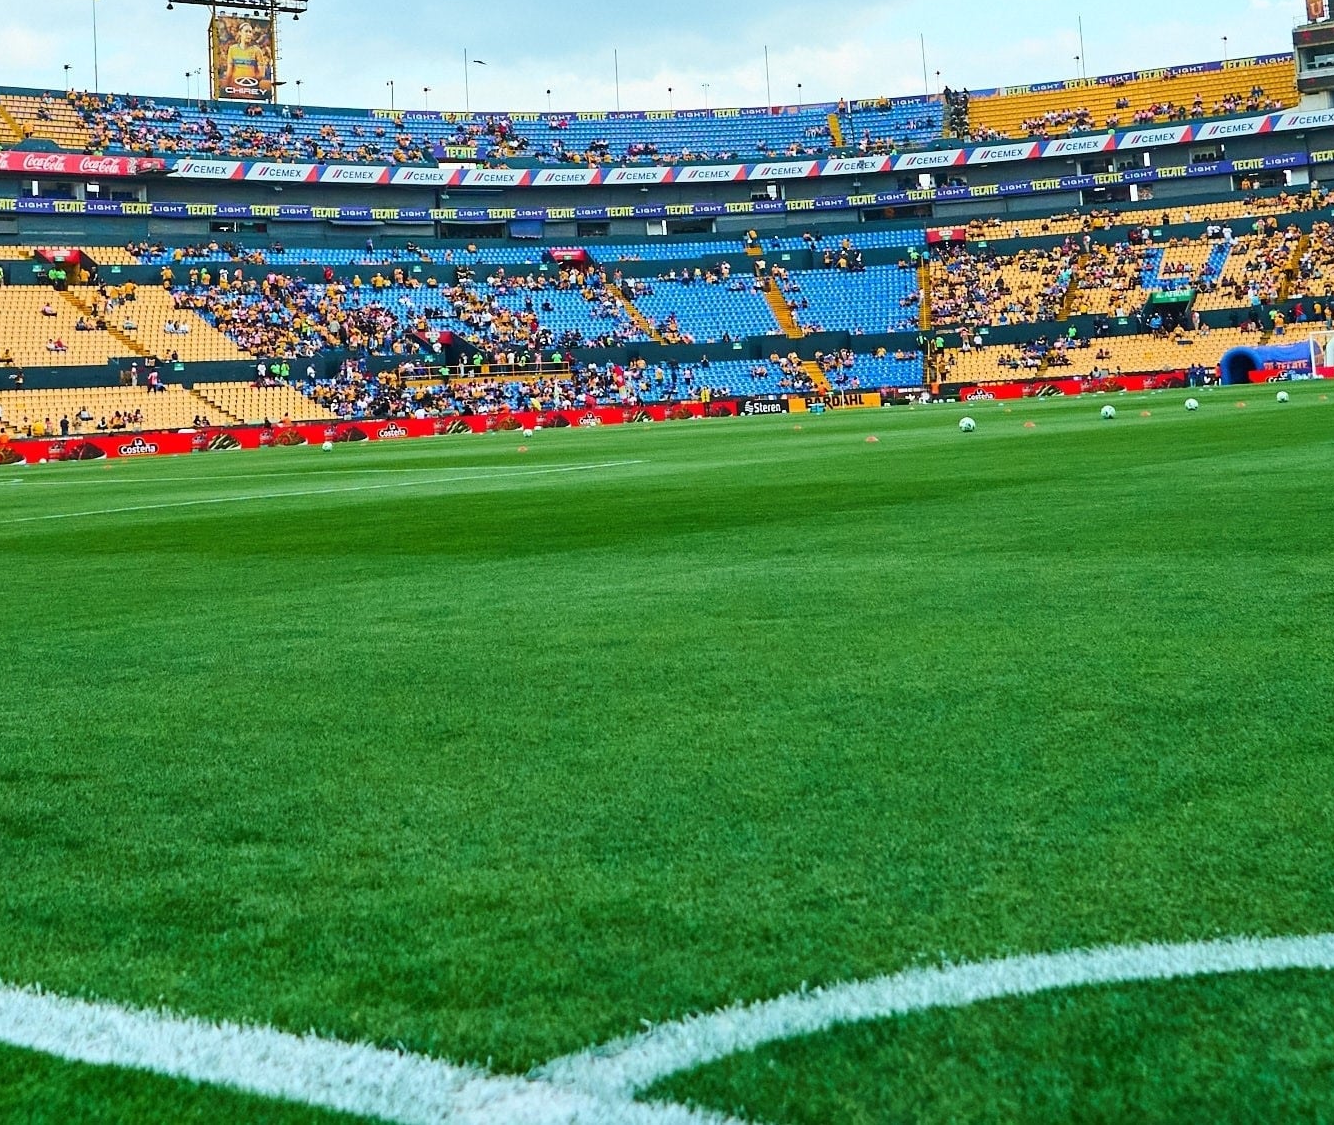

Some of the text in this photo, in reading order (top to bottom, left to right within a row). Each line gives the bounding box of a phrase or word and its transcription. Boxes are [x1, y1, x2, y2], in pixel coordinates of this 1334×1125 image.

[1258, 55, 1292, 65] LIGHT
[1063, 78, 1097, 89] TECATE
[225, 87, 267, 95] CHIREY
[891, 98, 921, 106] LIGHT
[644, 110, 707, 121] TECATE LIGHT
[712, 107, 767, 118] TECATE LIGHT
[1299, 114, 1334, 125] CEMEX
[1219, 123, 1254, 134] CEMEX
[1066, 141, 1099, 151] CEMEX
[444, 146, 477, 159] TECATE
[916, 155, 949, 165] CEMEX
[193, 165, 227, 175] CEMEX
[342, 170, 373, 179] CEMEX
[771, 167, 803, 176] CEMEX
[1156, 164, 1217, 178] TECATE LIGHT
[483, 173, 514, 182] CEMEX
[626, 172, 657, 181] CEMEX
[906, 188, 965, 201] TECATE LIGHT
[185, 202, 217, 215] TECATE
[429, 208, 458, 219] TECATE
[665, 204, 694, 216] TECATE
[805, 393, 865, 410] BARDAHL
[754, 402, 781, 414] Steren
[120, 445, 156, 454] Costeña
